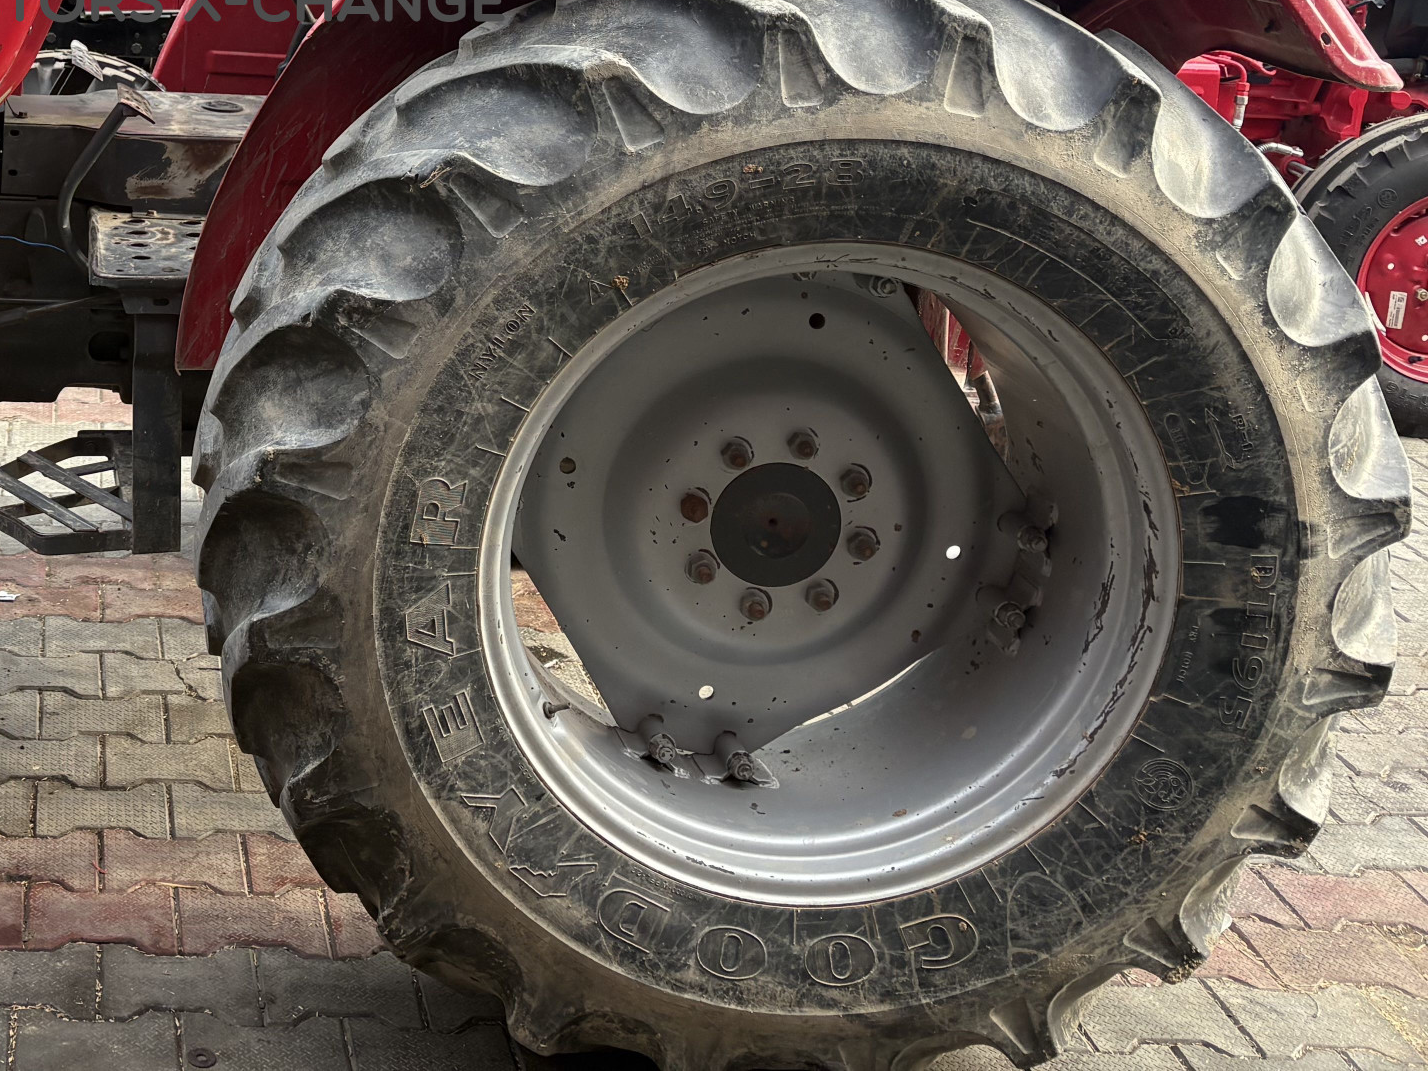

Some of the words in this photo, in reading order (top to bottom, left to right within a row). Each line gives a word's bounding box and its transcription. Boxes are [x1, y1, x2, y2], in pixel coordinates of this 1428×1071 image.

[630, 158, 865, 239] 14.9-28
[468, 302, 537, 381] NYLON
[1219, 554, 1279, 729] DT195
[404, 476, 979, 987] GOODYEAR
